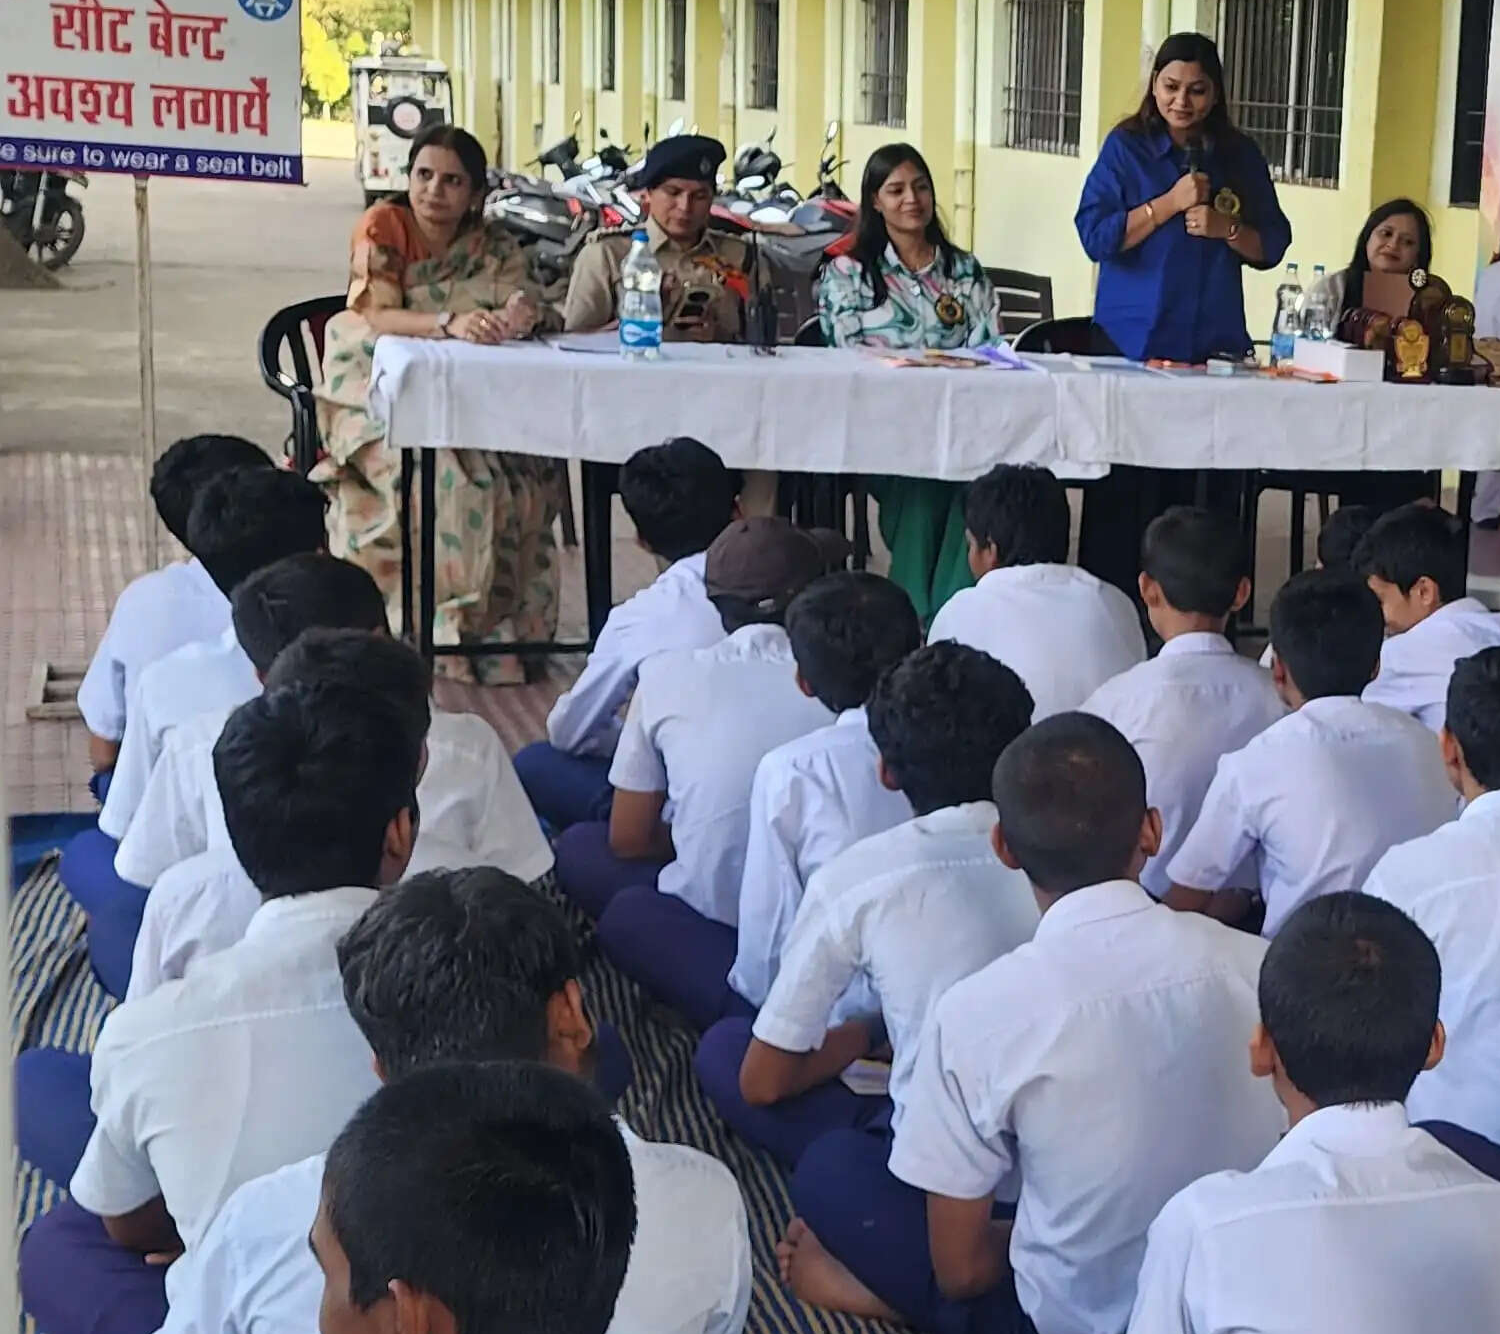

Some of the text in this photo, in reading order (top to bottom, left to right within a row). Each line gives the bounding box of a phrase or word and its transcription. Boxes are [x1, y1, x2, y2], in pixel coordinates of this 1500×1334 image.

[7, 73, 135, 127] अवश्य
[23, 144, 76, 165] sure
[83, 144, 105, 166] to
[110, 150, 168, 171] wear
[174, 154, 190, 172] a
[196, 154, 244, 176] seat
[251, 156, 293, 179] belt
